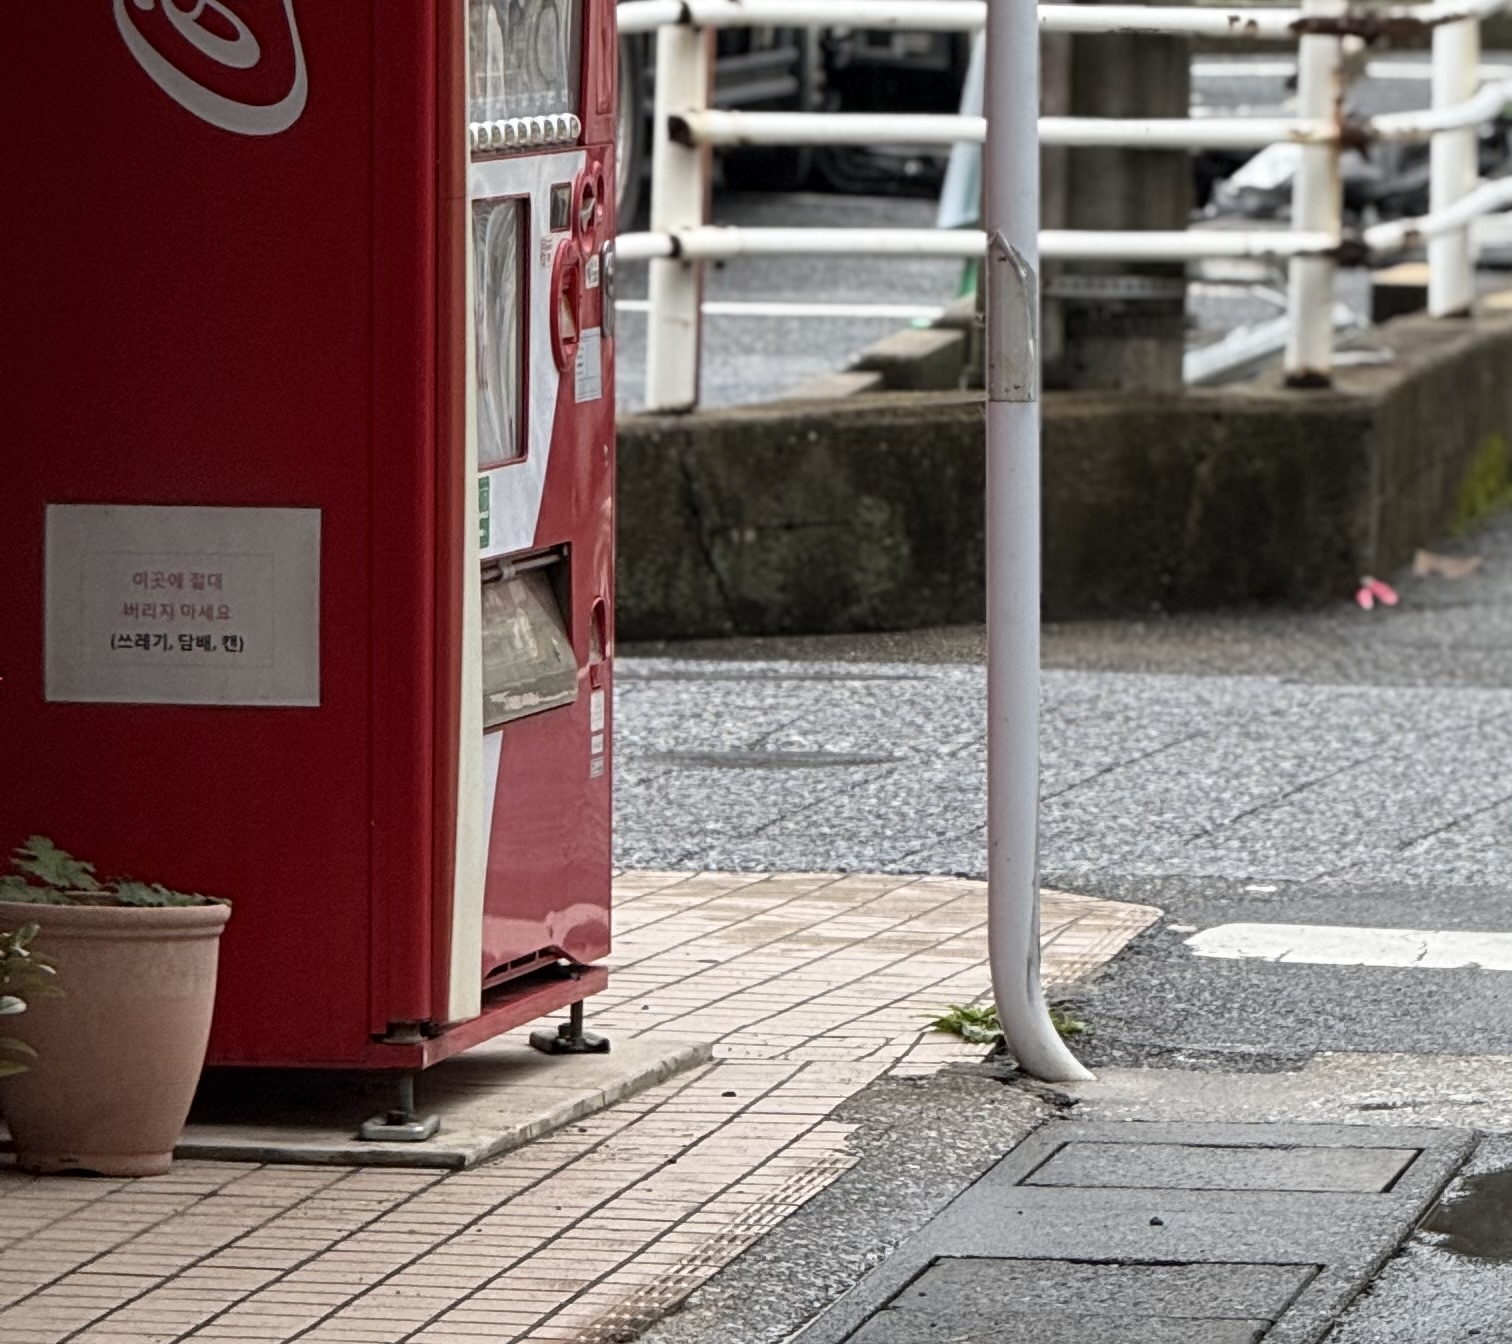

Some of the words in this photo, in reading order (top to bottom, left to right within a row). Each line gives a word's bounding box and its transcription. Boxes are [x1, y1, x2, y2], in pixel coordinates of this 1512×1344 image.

[132, 571, 184, 590] 이곳에
[190, 571, 223, 590] 절대
[123, 602, 175, 620] 버리지
[180, 603, 231, 621] 마세요
[110, 632, 173, 652] (쓰레기,
[178, 633, 217, 652] 담배,
[221, 634, 245, 653] 캔)
